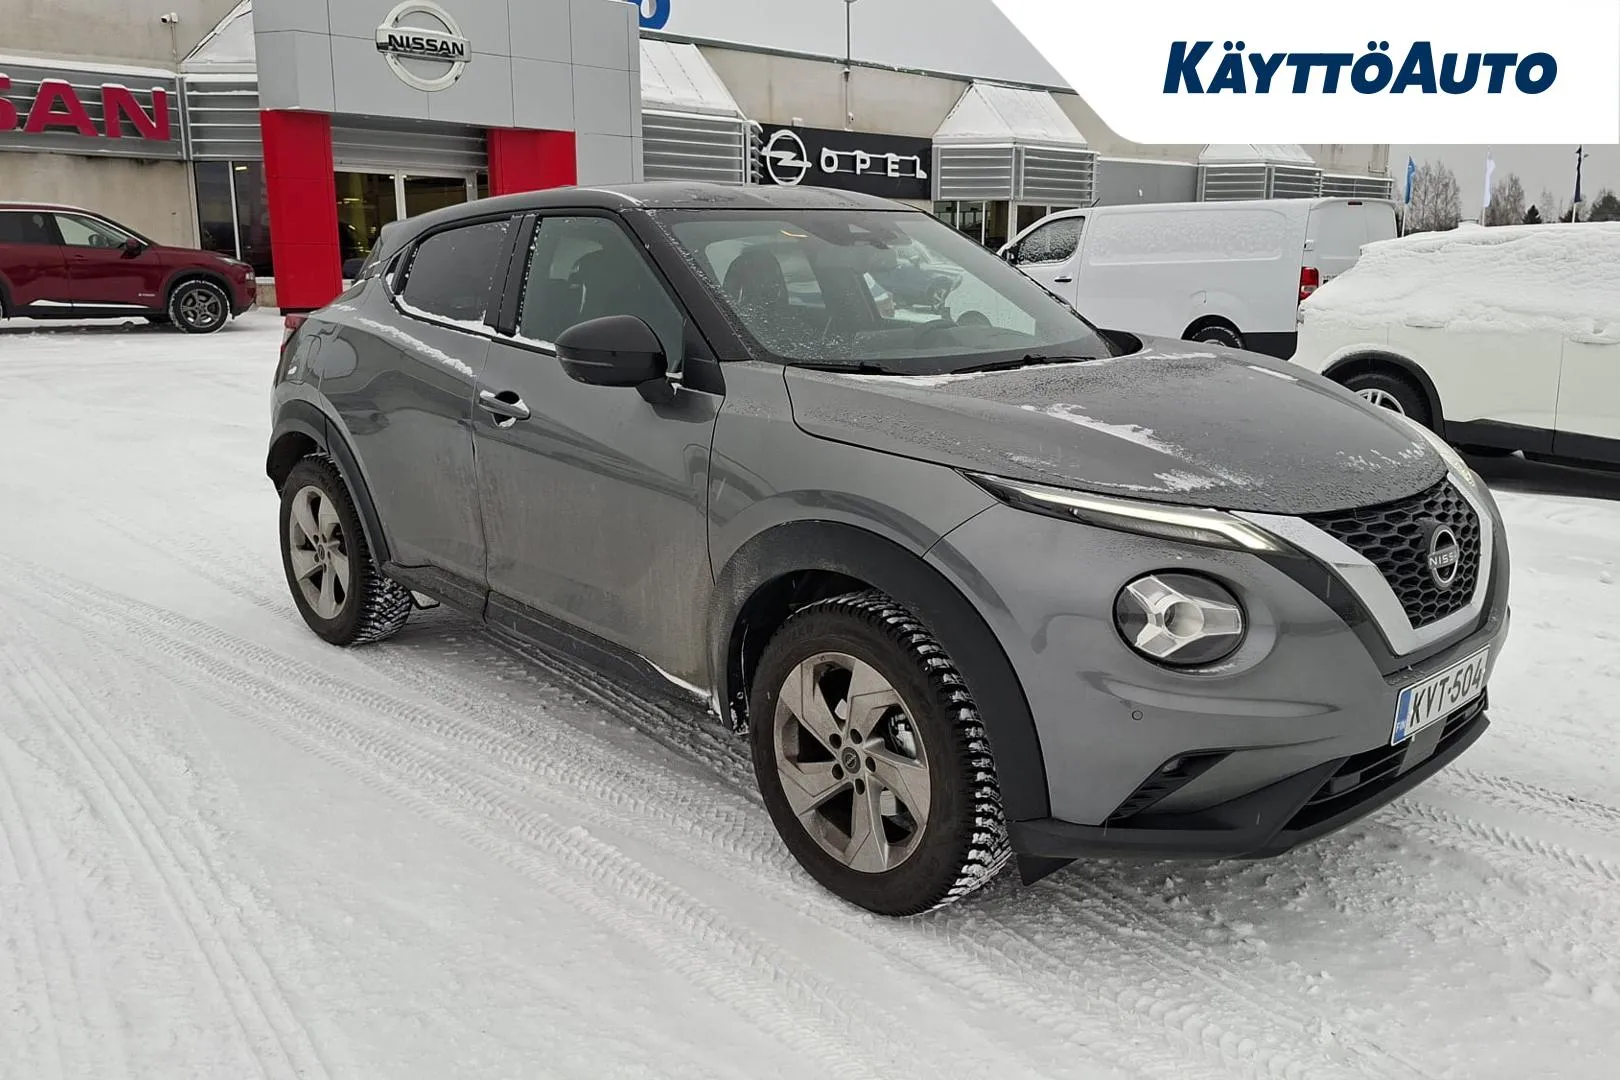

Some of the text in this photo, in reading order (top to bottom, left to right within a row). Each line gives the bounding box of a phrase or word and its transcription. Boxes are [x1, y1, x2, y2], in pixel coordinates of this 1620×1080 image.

[388, 34, 464, 56] NISSAN
[0, 73, 170, 140] AN
[821, 147, 928, 179] OPEL
[1410, 658, 1484, 727] KVT-504
